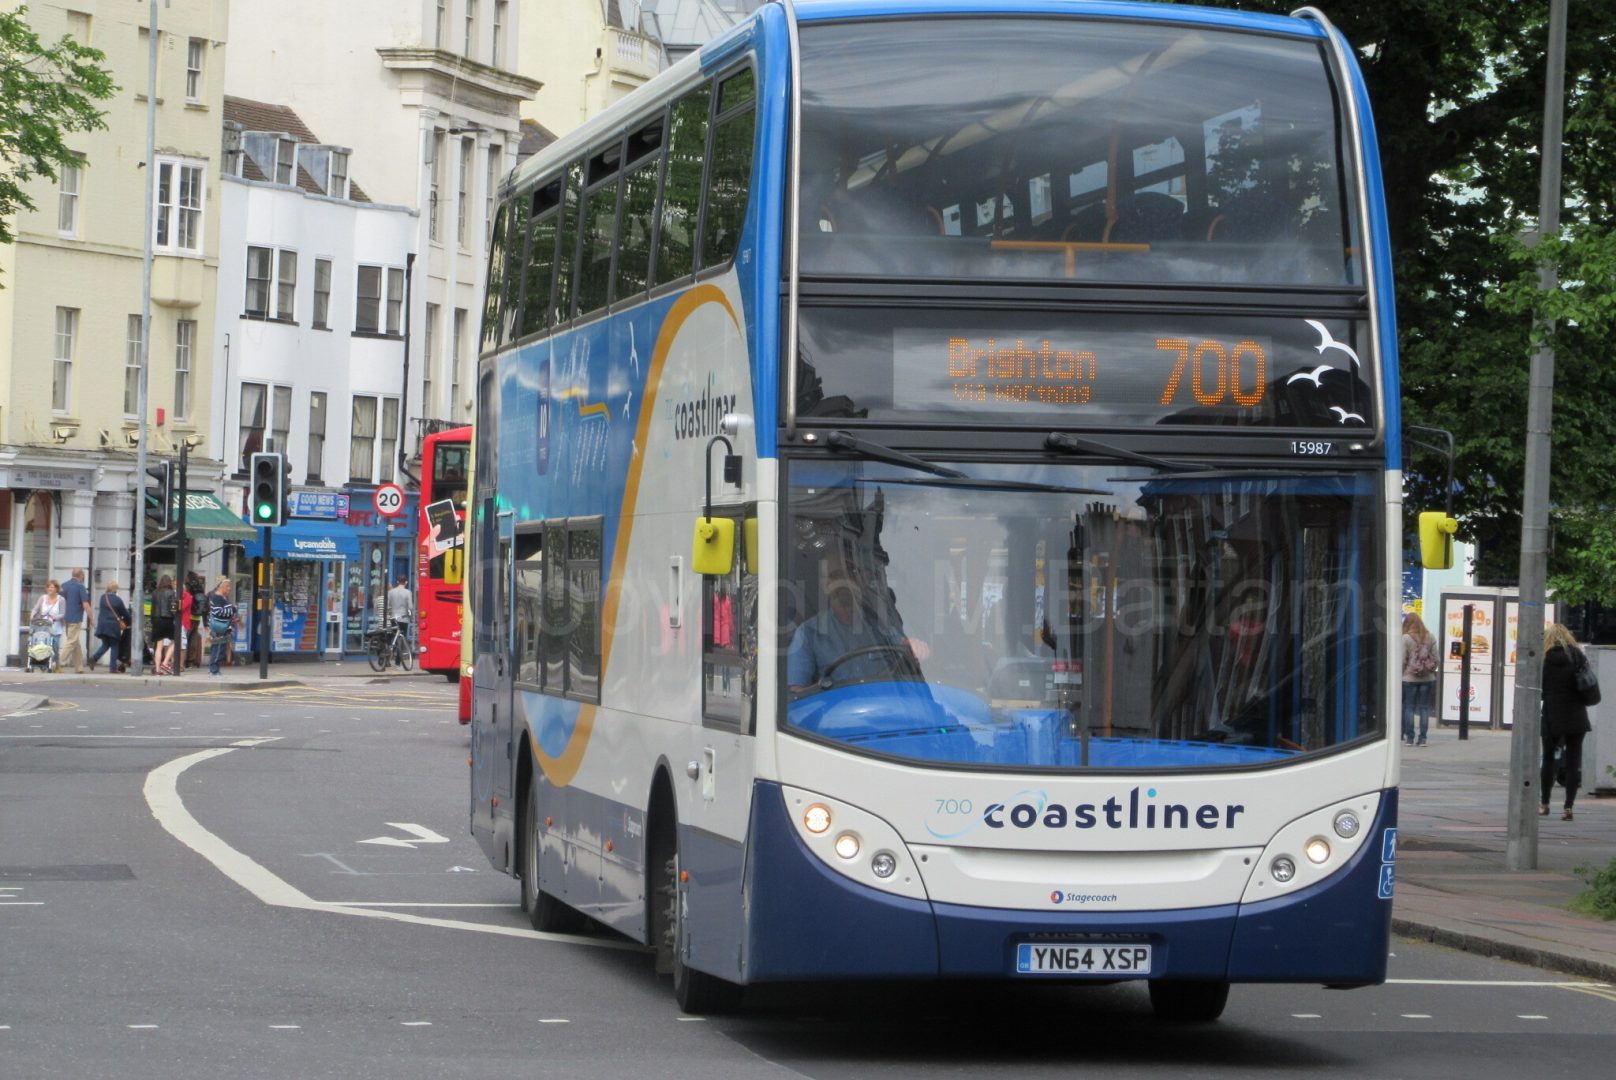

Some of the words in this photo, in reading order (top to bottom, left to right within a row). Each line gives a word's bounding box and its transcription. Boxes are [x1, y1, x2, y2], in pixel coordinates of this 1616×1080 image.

[949, 338, 1096, 379] Brighton
[1155, 338, 1266, 407] 700
[1291, 441, 1332, 455] 15987
[378, 493, 400, 507] 20
[294, 537, 337, 550] Lycamobile
[935, 799, 973, 816] 700
[983, 785, 1245, 830] coastliner
[1066, 892, 1117, 904] Stagecoach
[1035, 948, 1094, 970] YN64
[1102, 948, 1147, 970] XSP
